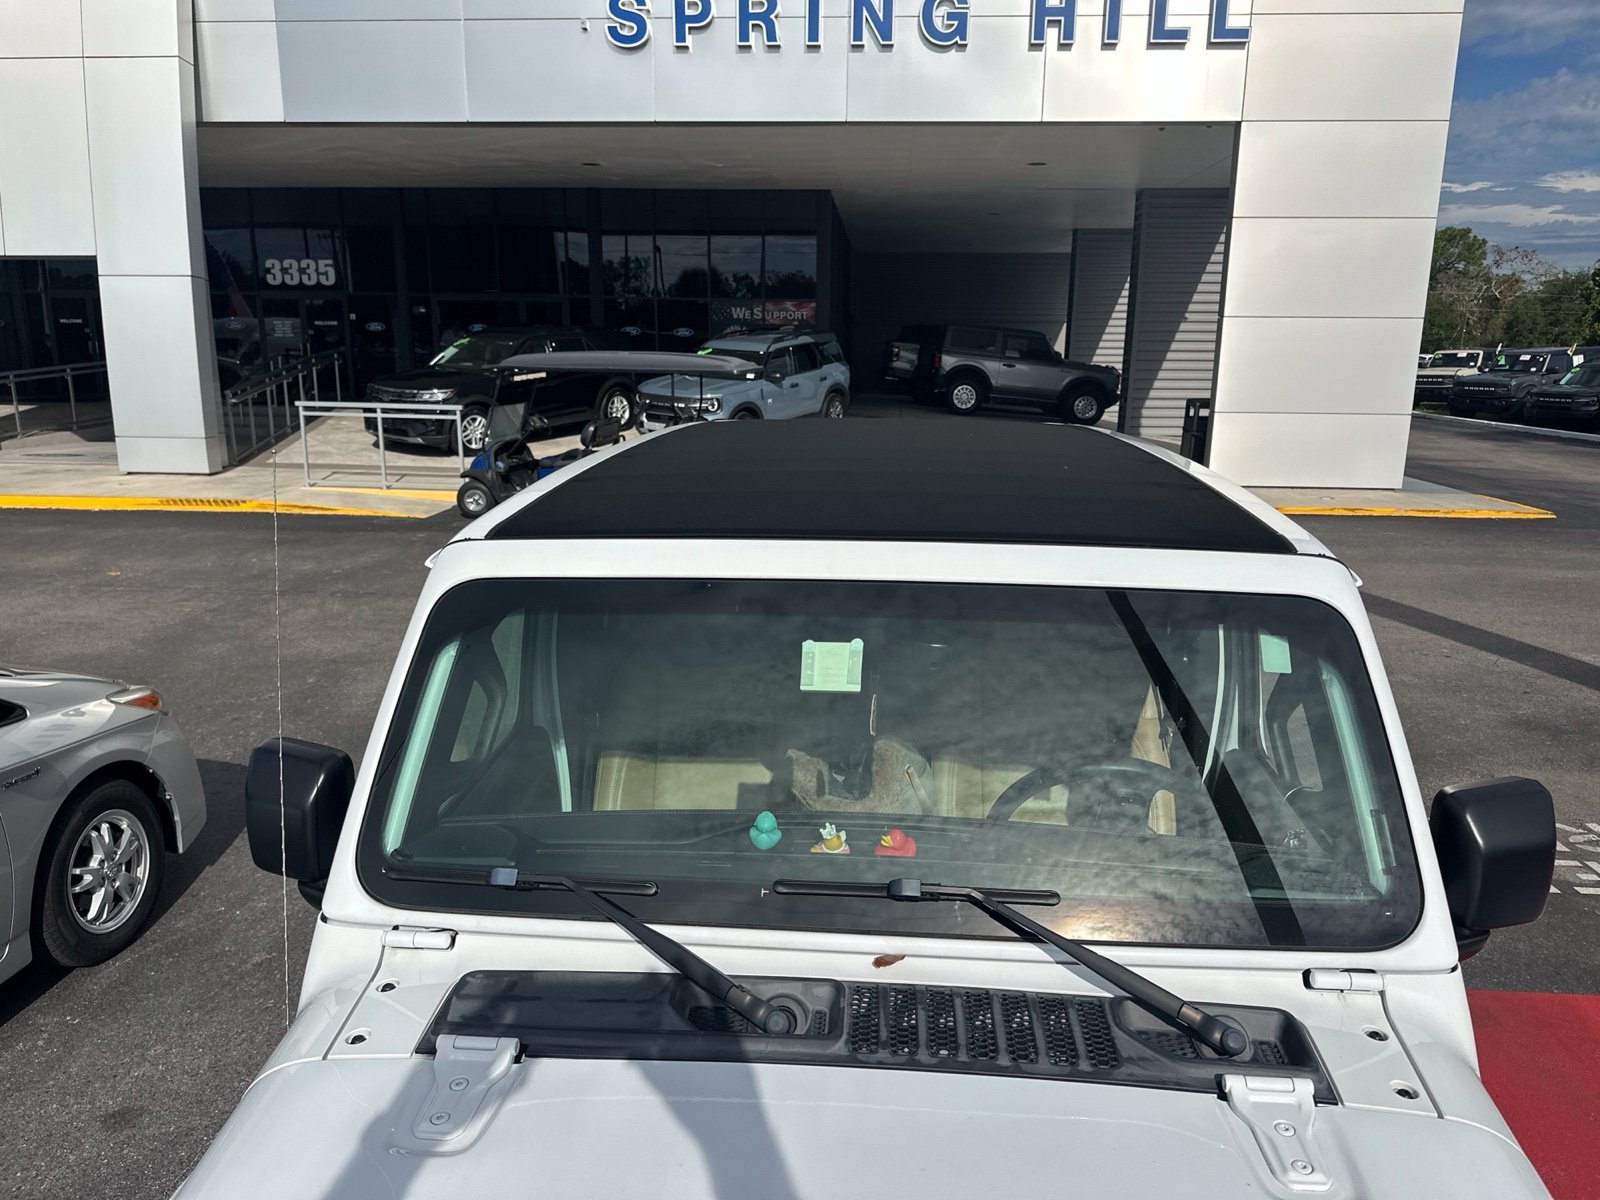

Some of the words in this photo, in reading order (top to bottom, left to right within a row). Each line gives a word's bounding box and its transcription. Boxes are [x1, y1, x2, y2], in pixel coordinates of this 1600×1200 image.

[605, 0, 970, 48] SPRING
[1029, 0, 1251, 45] HILL
[265, 258, 336, 286] 3335
